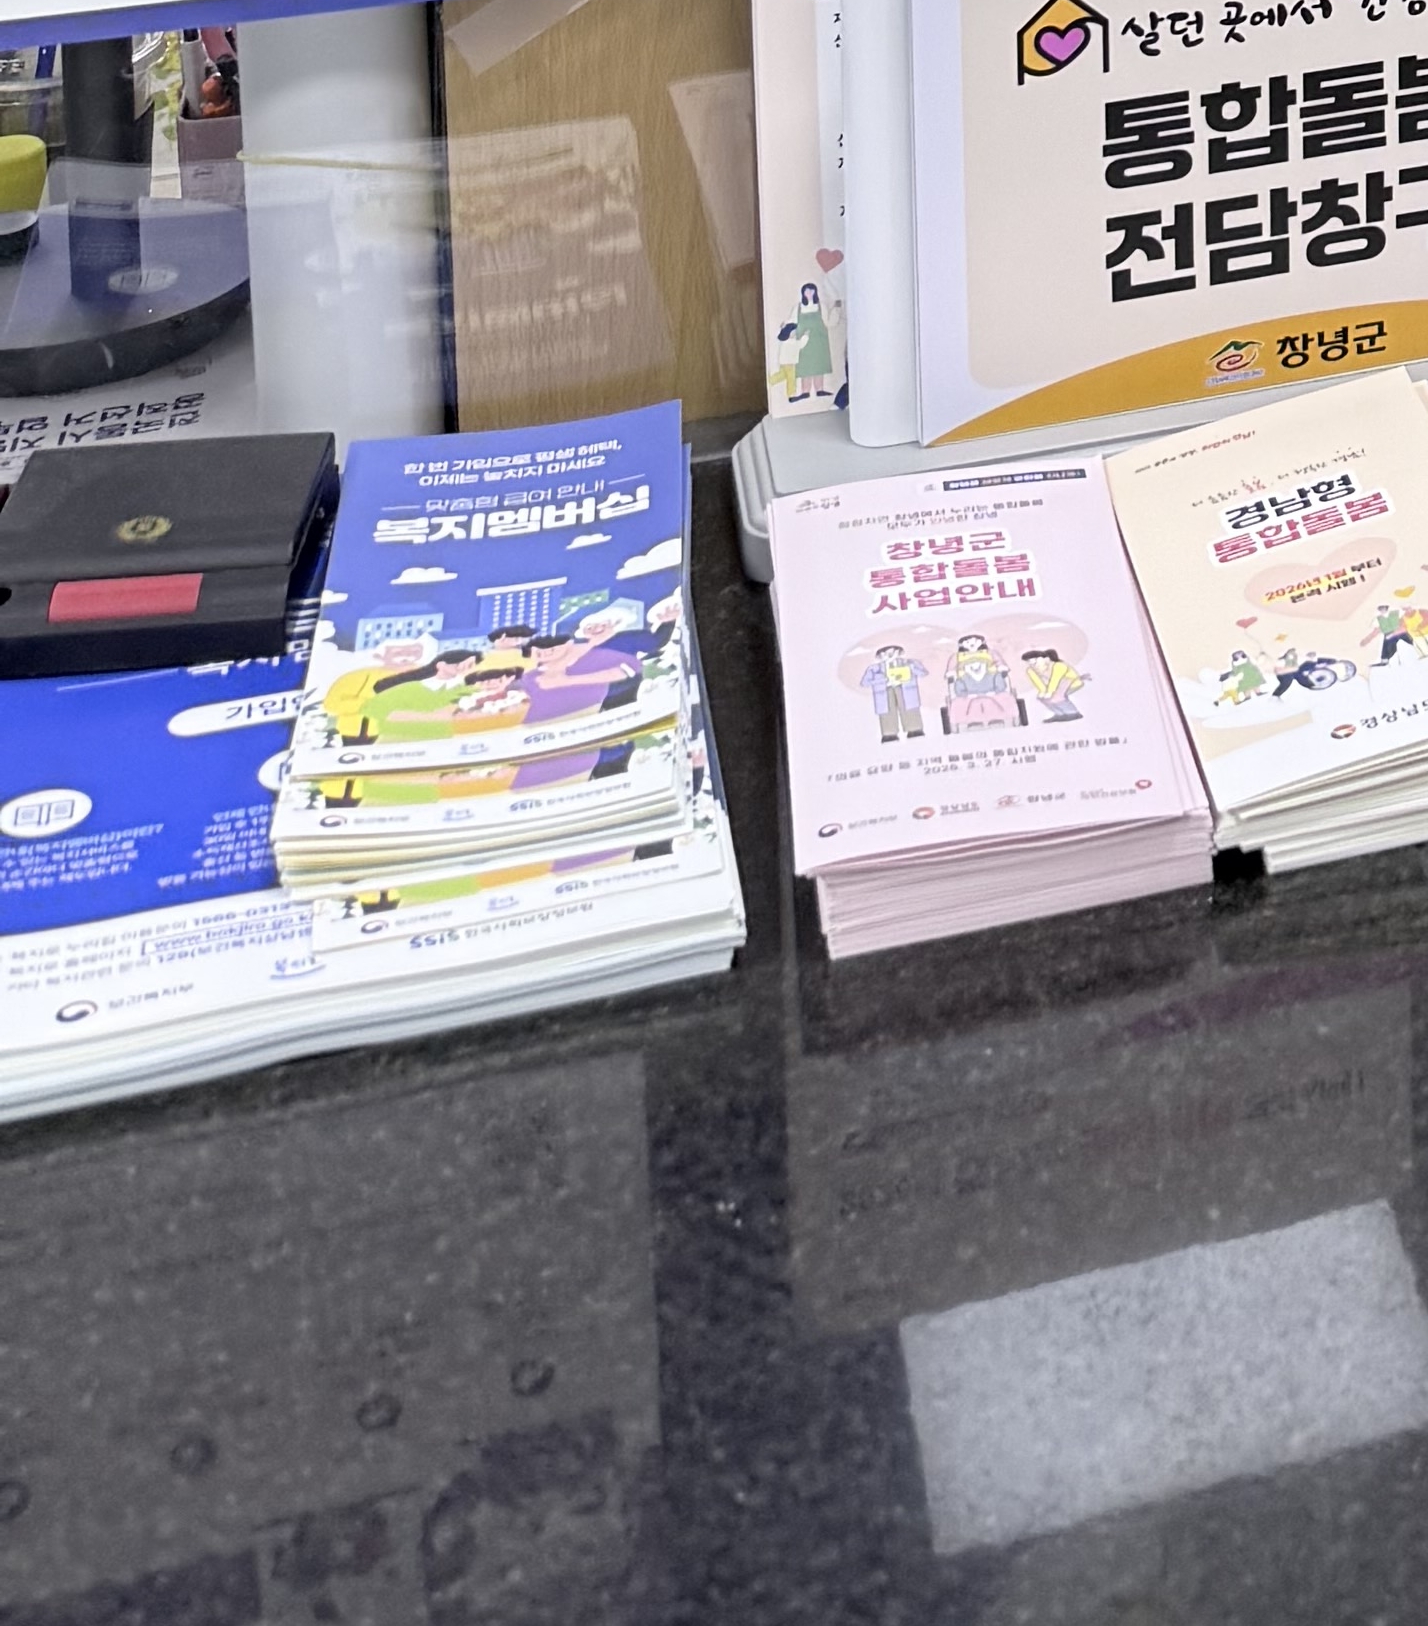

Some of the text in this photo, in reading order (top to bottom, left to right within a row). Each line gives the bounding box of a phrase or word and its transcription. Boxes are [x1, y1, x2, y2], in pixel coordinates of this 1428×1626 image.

[1121, 11, 1204, 56] 살던
[1277, 321, 1390, 373] 창녕군
[373, 485, 649, 544] 복지멤버십
[1226, 475, 1355, 529] 경남형
[887, 532, 1005, 560] 창녕군
[1214, 492, 1388, 563] 통합돌봄
[870, 554, 1030, 588] 통합돌봄
[873, 578, 1035, 613] 사업안내
